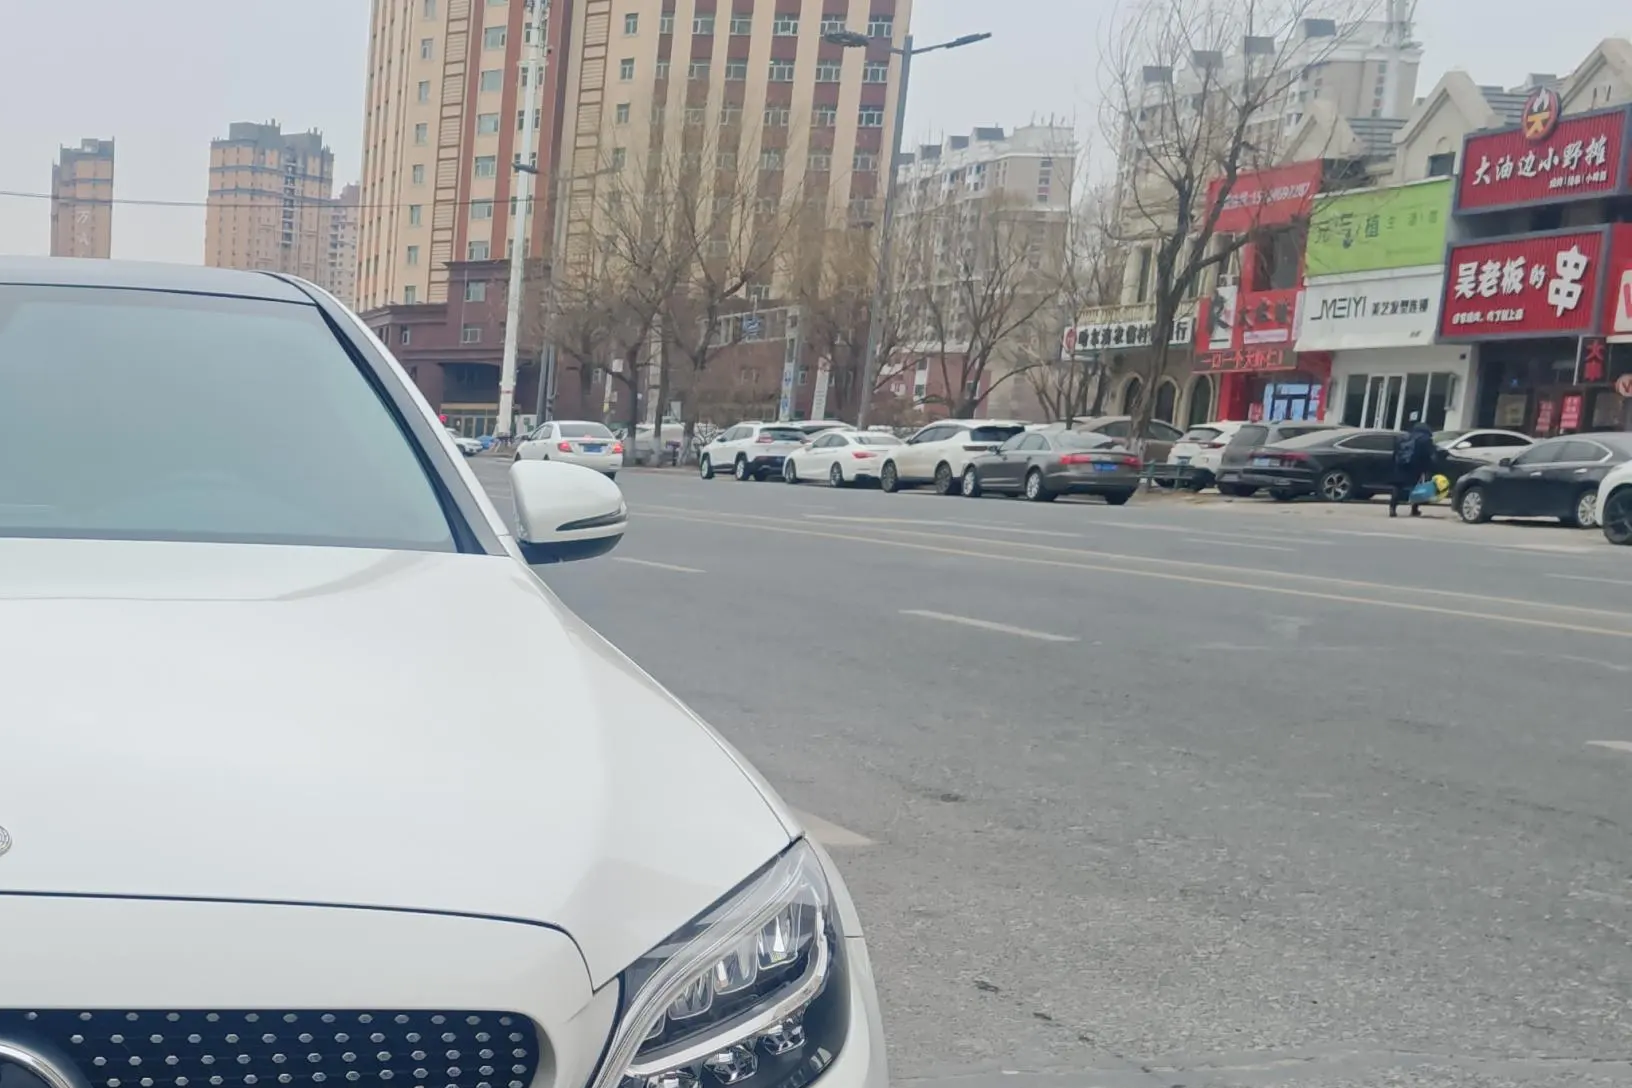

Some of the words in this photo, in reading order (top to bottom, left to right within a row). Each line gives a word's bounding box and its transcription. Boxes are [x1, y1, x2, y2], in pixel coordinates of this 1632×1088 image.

[1454, 244, 1589, 318] 吴老板的串
[1310, 296, 1367, 320] MEIYI
